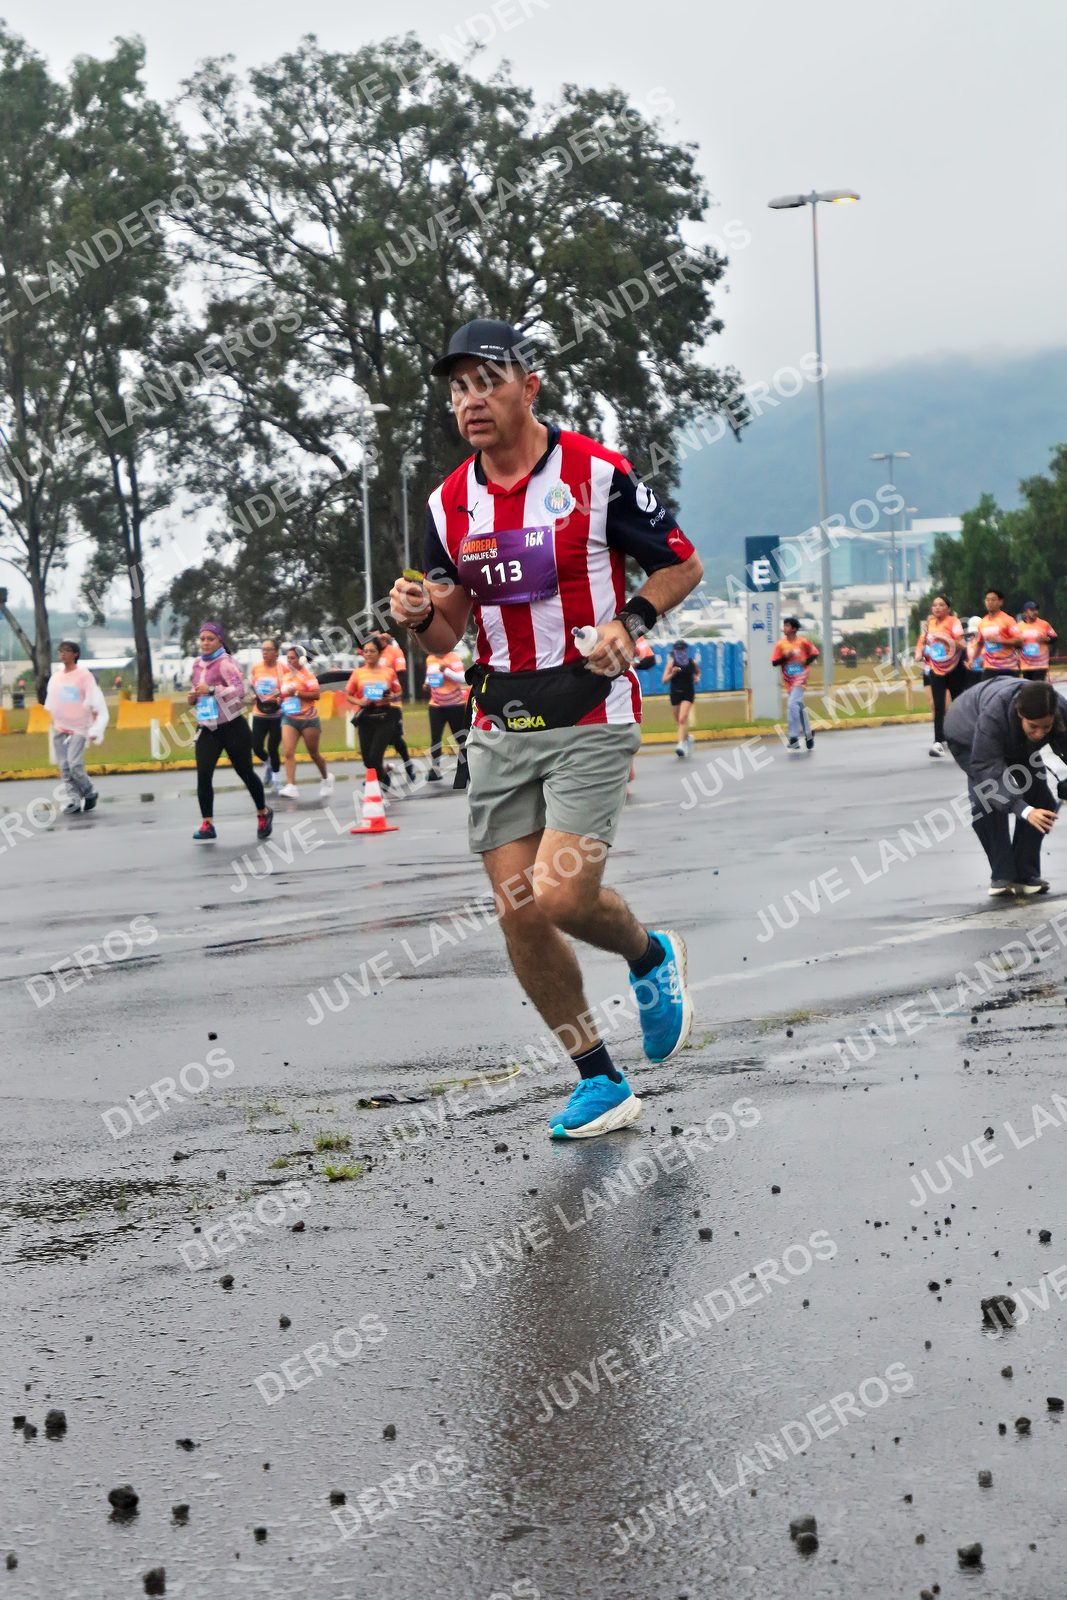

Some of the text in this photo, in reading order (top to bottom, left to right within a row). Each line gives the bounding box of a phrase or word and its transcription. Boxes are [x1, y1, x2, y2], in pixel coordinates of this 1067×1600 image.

[463, 538, 497, 553] CARRERA
[524, 531, 544, 547] 16K
[480, 560, 523, 585] 113
[752, 560, 770, 585] E
[766, 602, 774, 643] General
[507, 715, 546, 729] HOKA
